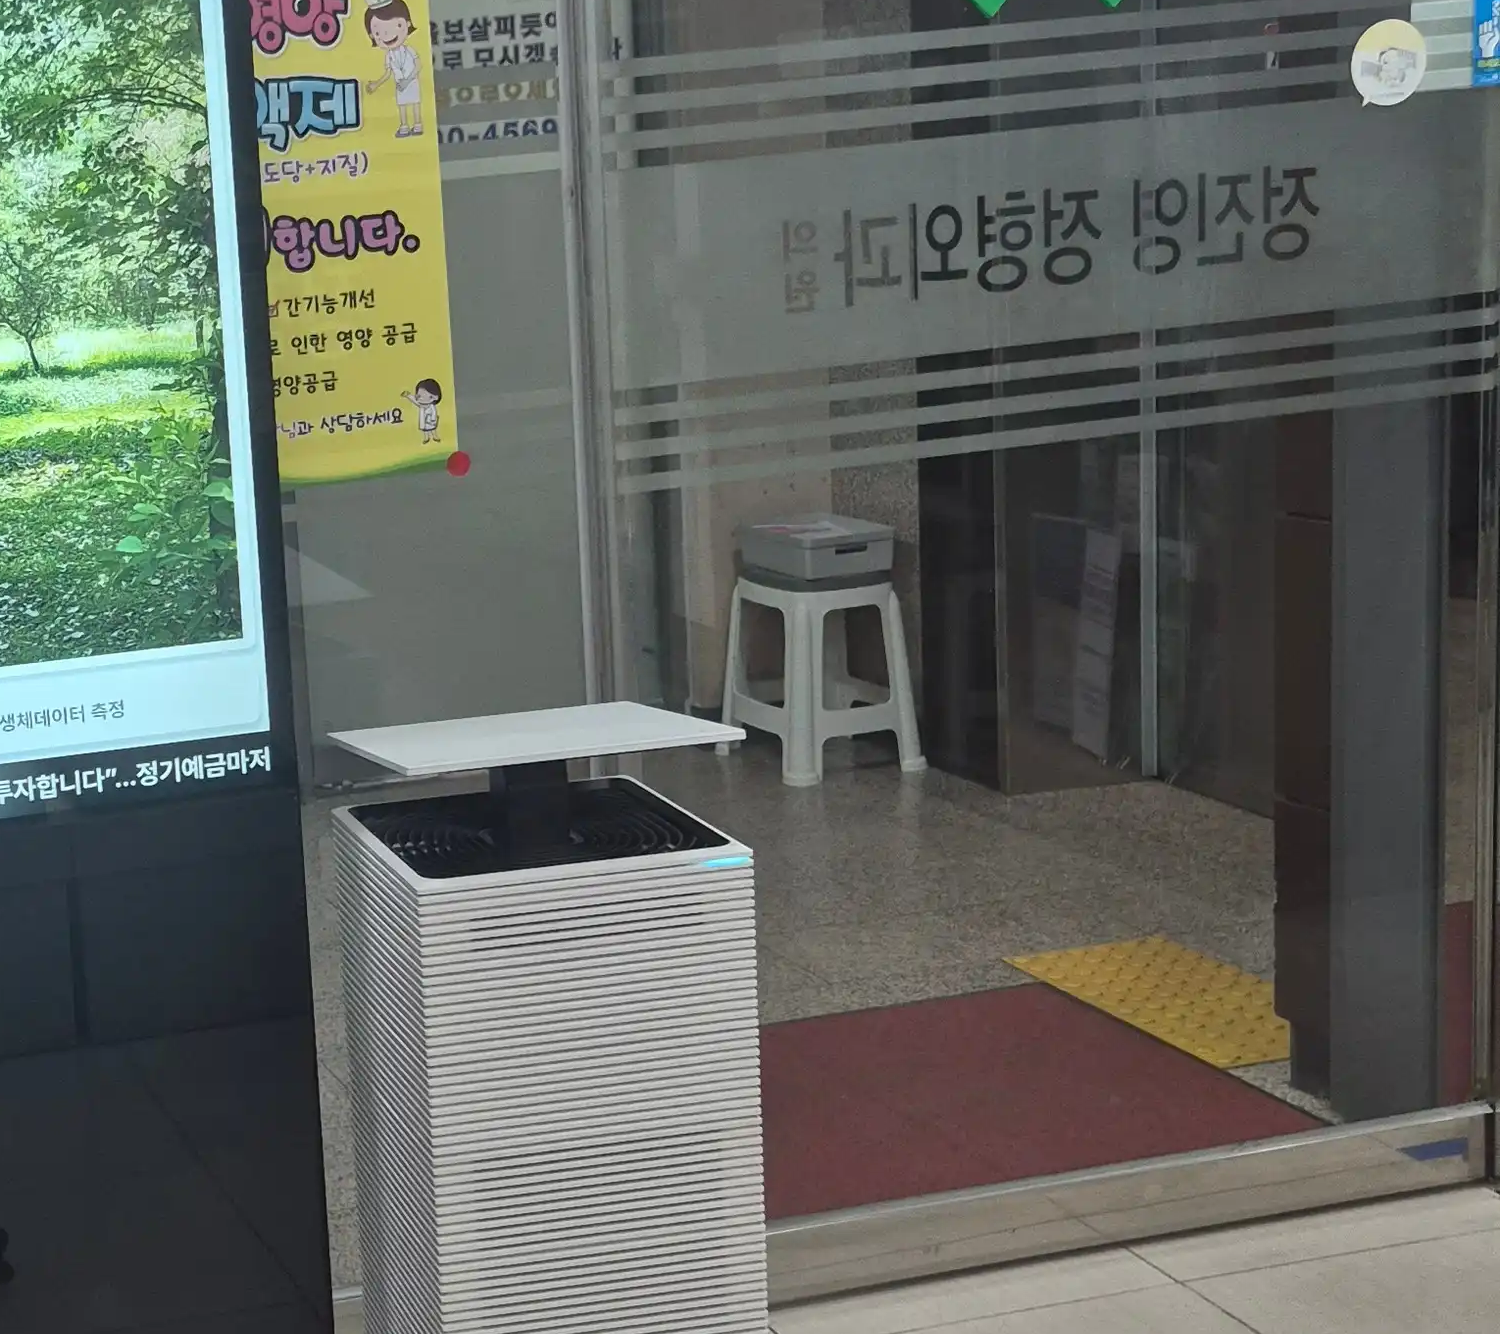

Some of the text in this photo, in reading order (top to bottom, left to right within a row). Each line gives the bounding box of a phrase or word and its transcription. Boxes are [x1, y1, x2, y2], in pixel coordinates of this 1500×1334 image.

[262, 208, 420, 273] 합니다.
[284, 289, 376, 317] 간기능개선
[291, 333, 327, 356] 인한
[337, 327, 373, 351] 영양
[382, 323, 418, 345] 공급
[320, 407, 405, 435] 상담하세요
[0, 706, 86, 733] 생체데이터
[90, 700, 125, 722] 측정
